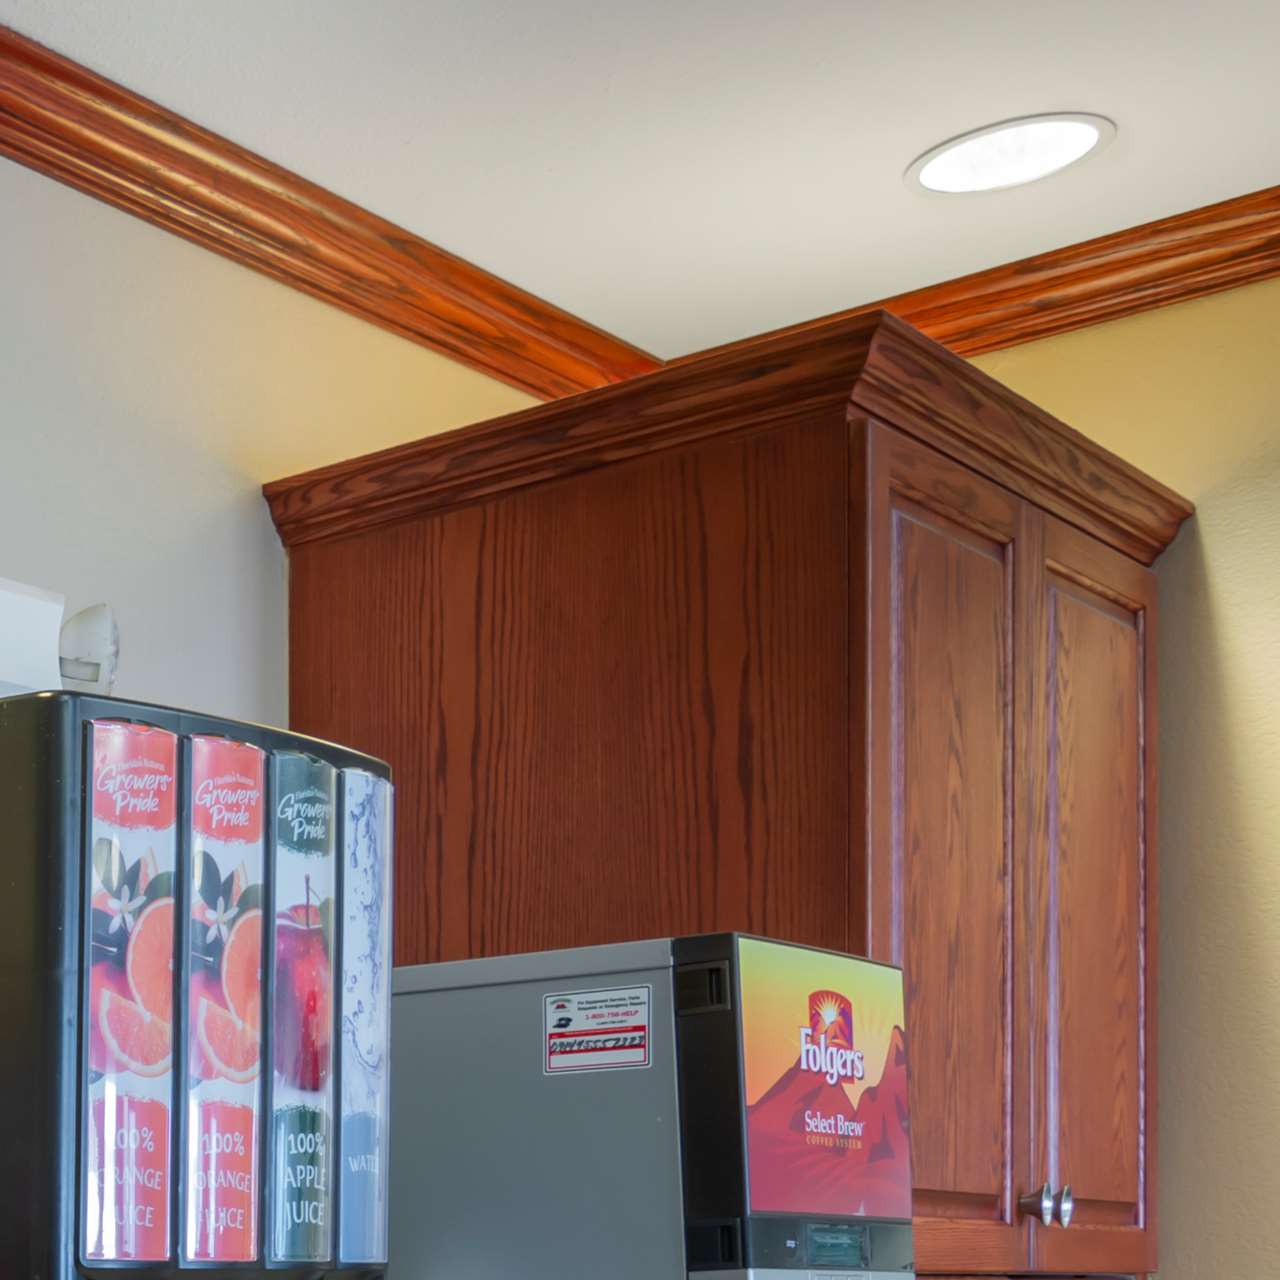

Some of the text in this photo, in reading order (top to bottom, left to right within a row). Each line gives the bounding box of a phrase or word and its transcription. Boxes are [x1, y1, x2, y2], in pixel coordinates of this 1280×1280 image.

[113, 790, 160, 816] Pride
[210, 805, 249, 829] Pride
[291, 817, 326, 841] Pride
[800, 1027, 864, 1085] Folgers
[805, 1110, 864, 1136] Select Brew
[111, 1127, 154, 1152] 00%
[288, 1132, 325, 1156] 100%
[285, 1165, 325, 1190] APPLE
[110, 1205, 155, 1228] UICE
[285, 1201, 324, 1230] JUICE
